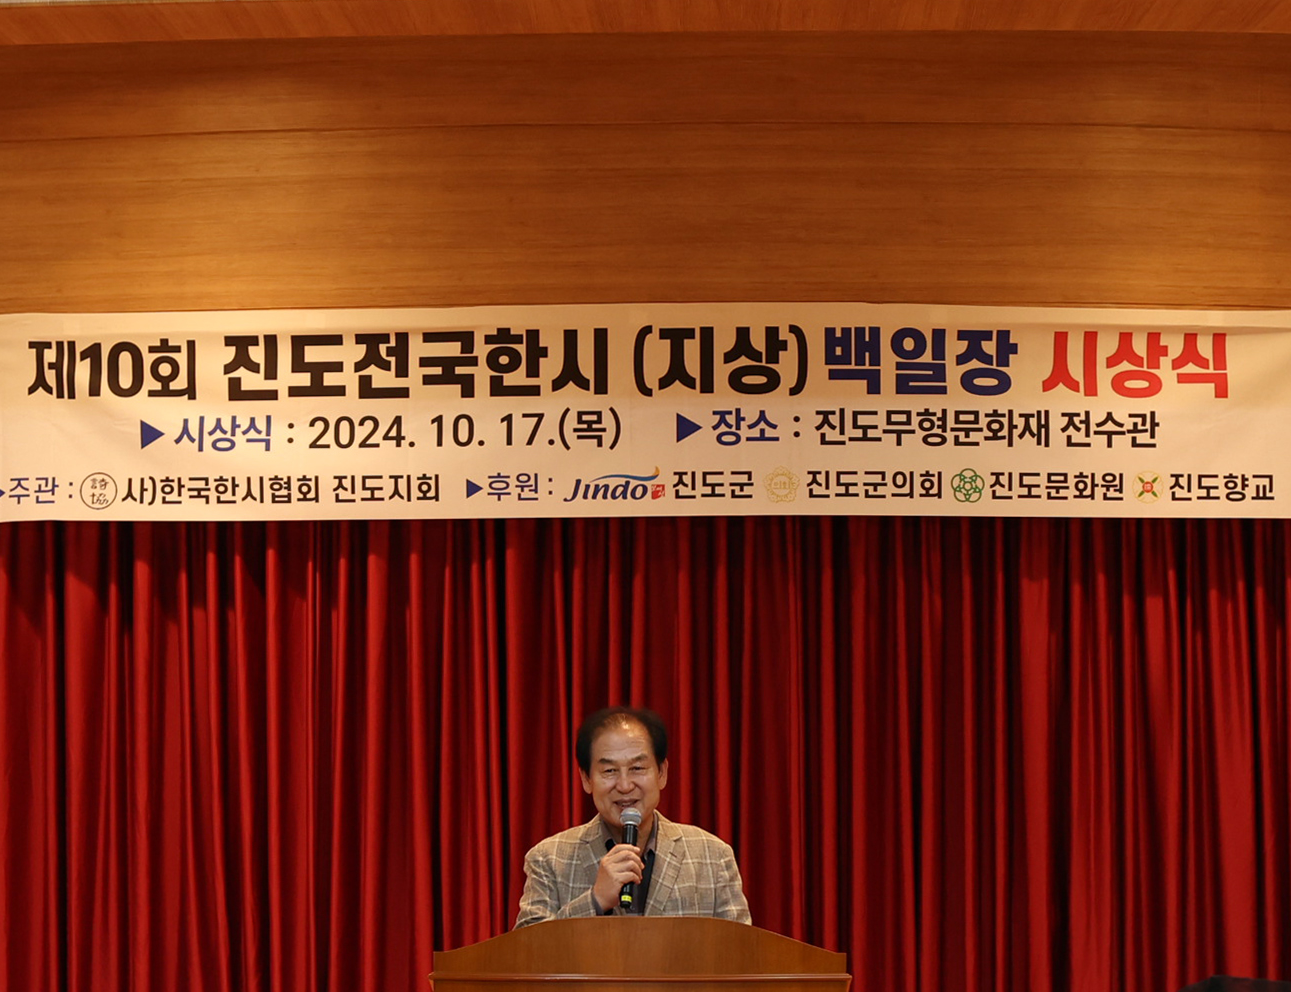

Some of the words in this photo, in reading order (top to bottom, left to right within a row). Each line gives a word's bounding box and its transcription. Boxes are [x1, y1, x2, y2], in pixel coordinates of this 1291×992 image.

[27, 337, 196, 400] 제10회
[223, 327, 609, 402] 진도전국한시
[633, 325, 809, 397] (지상)
[824, 326, 1019, 396] 백일장
[1041, 330, 1229, 398] 시상식
[173, 414, 272, 452] 시상식
[308, 415, 416, 449] 2024.
[430, 414, 486, 448] 10.
[711, 408, 780, 447] 장소
[814, 408, 1050, 448] 진도무형문화재
[1060, 410, 1160, 449] 전수관
[8, 477, 60, 504] 주관
[121, 475, 320, 506] 사)한국한시협회
[332, 473, 440, 503] 진도지회
[486, 472, 539, 502] 후원
[562, 478, 648, 502] Jindo
[672, 470, 755, 499] 진도군
[806, 469, 943, 500] 진도군의회
[989, 471, 1124, 502] 진도문화원
[1169, 472, 1276, 503] 진도향교
